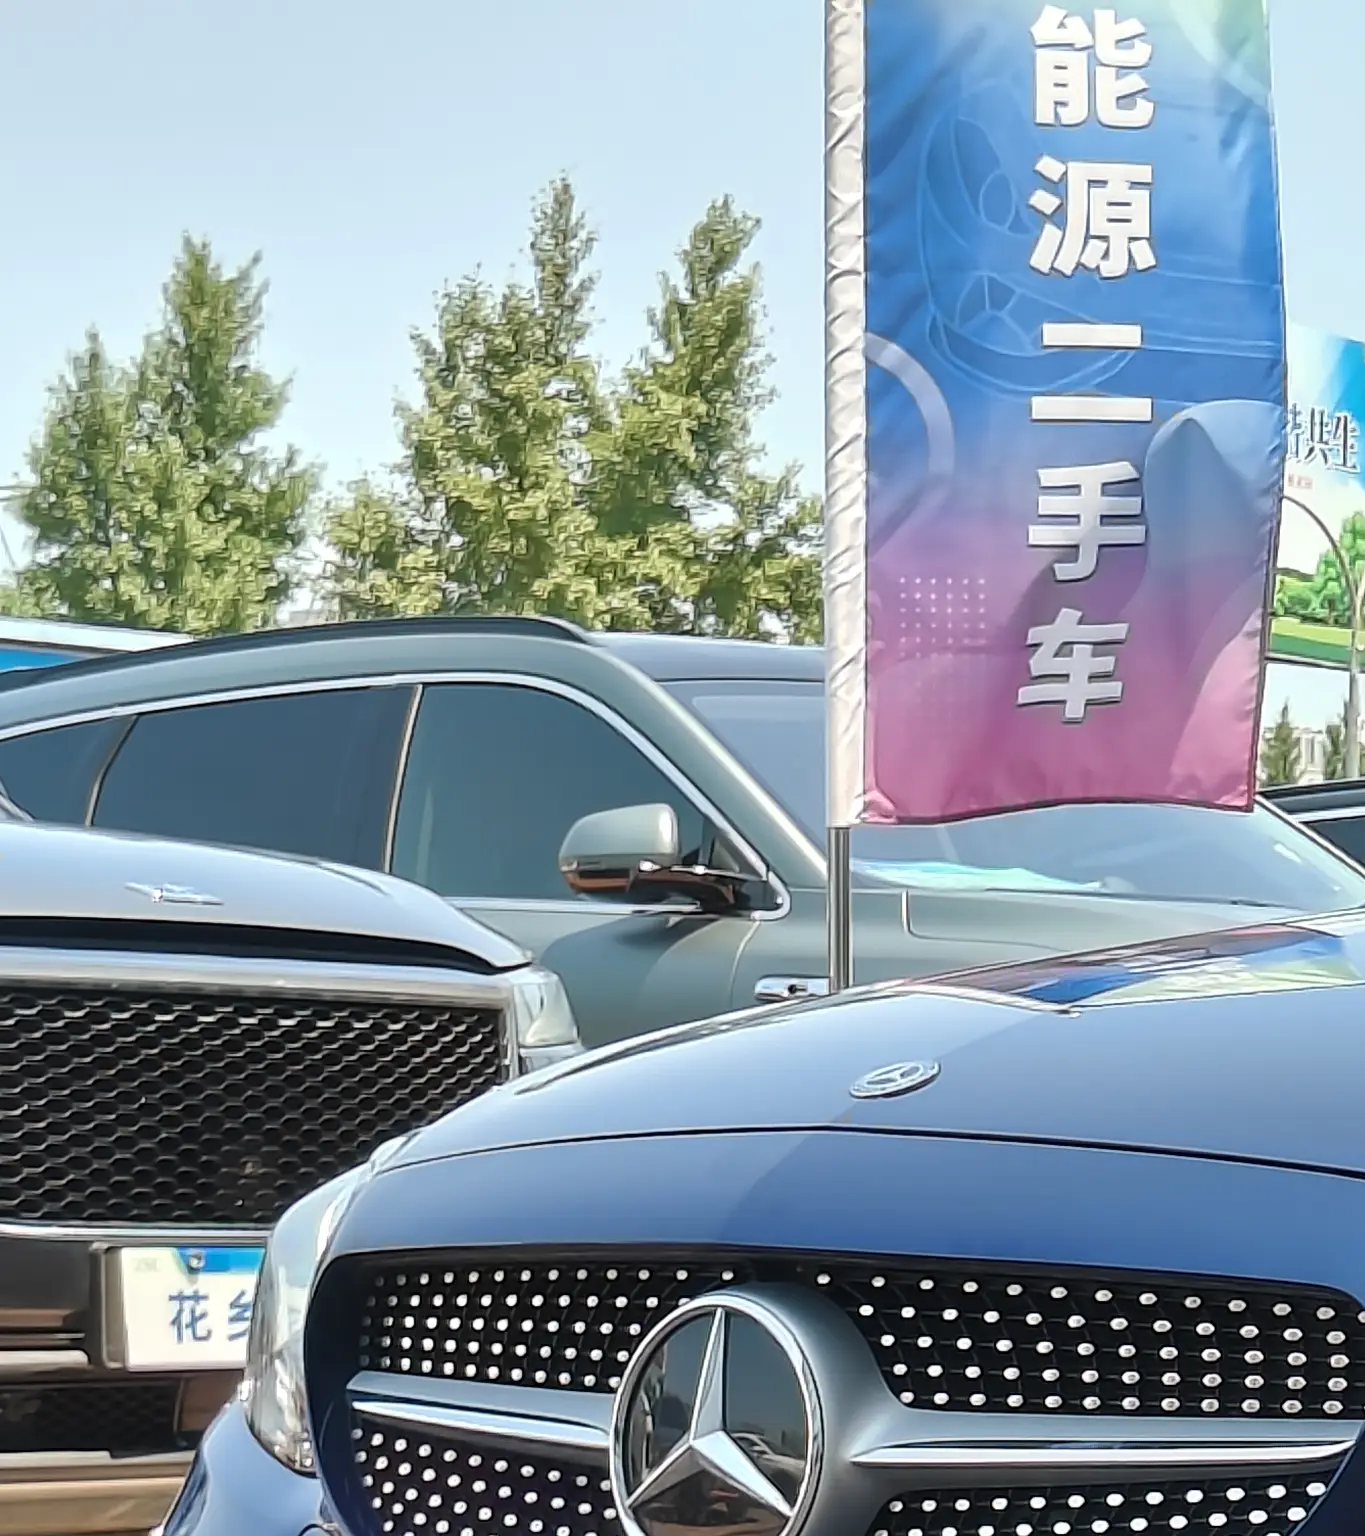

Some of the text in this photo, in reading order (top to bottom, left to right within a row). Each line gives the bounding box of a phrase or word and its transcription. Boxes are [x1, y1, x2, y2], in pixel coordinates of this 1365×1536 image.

[1017, 5, 1156, 724] 能源二手车
